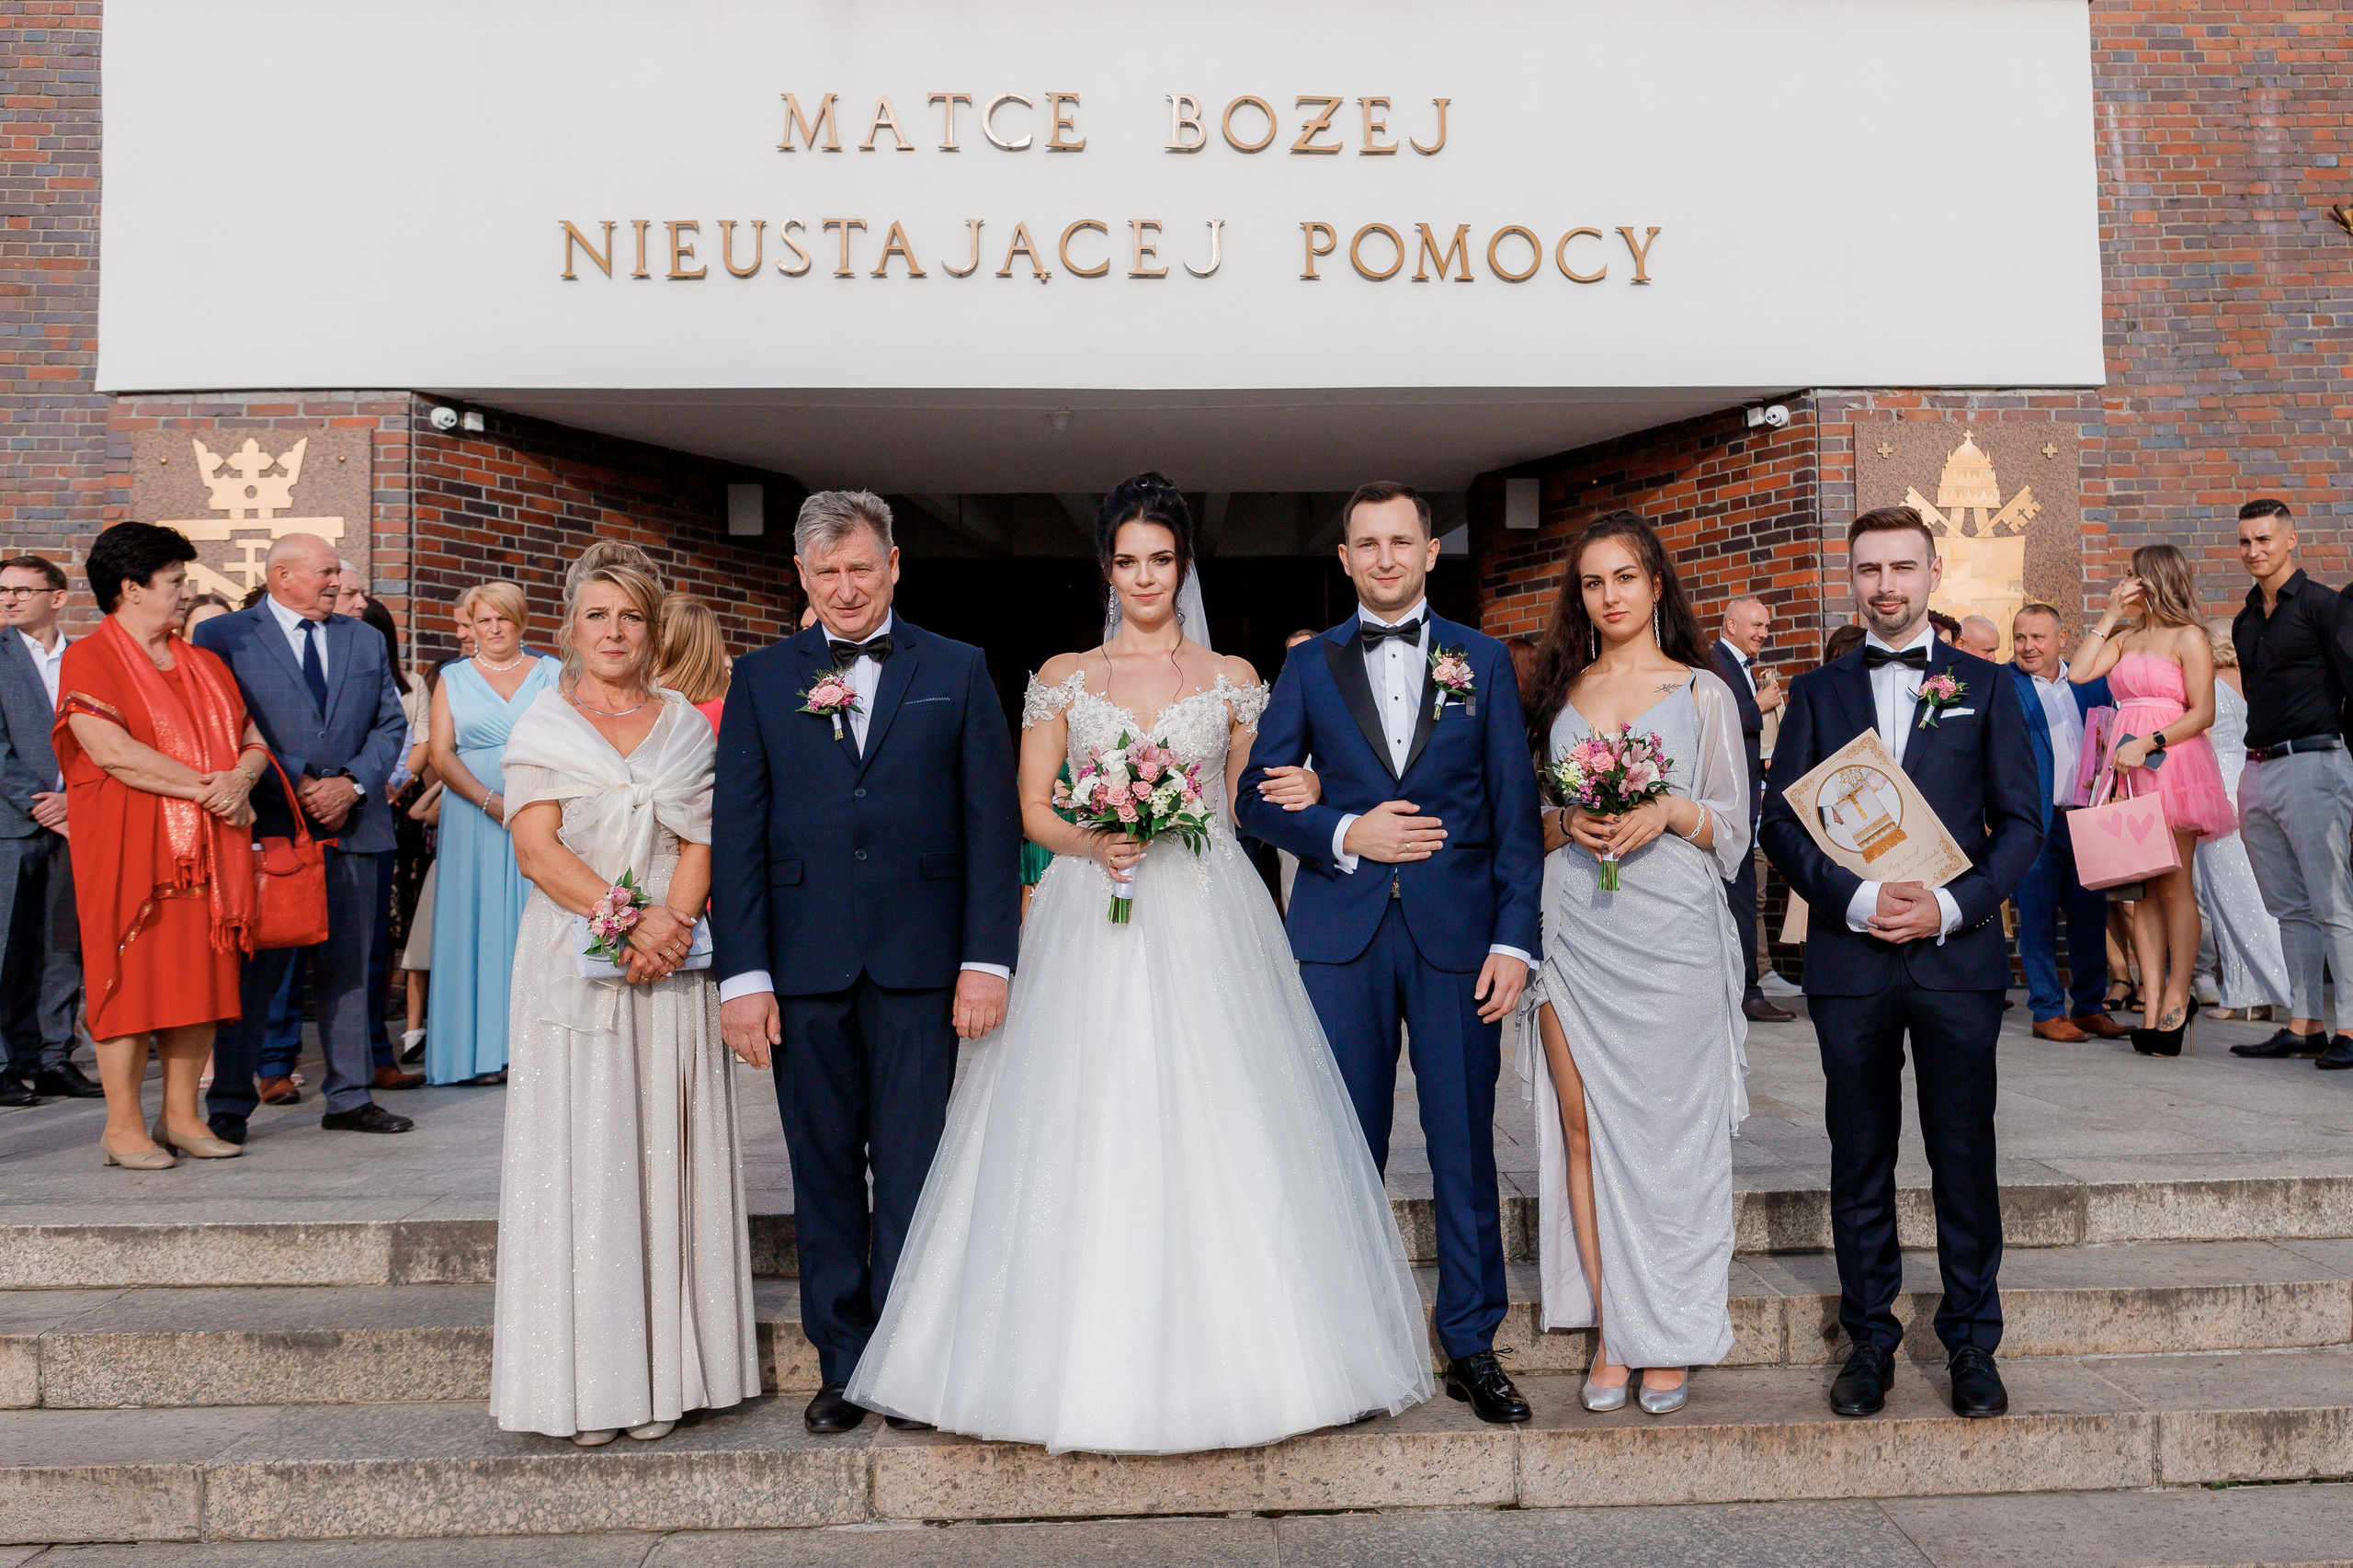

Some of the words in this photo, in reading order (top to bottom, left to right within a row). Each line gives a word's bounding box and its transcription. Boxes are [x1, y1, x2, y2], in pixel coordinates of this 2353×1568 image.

[776, 91, 1088, 154] MATCE
[557, 218, 1227, 286] NIEUSTAJĄCEJ
[1298, 222, 1663, 286] POMOCY
